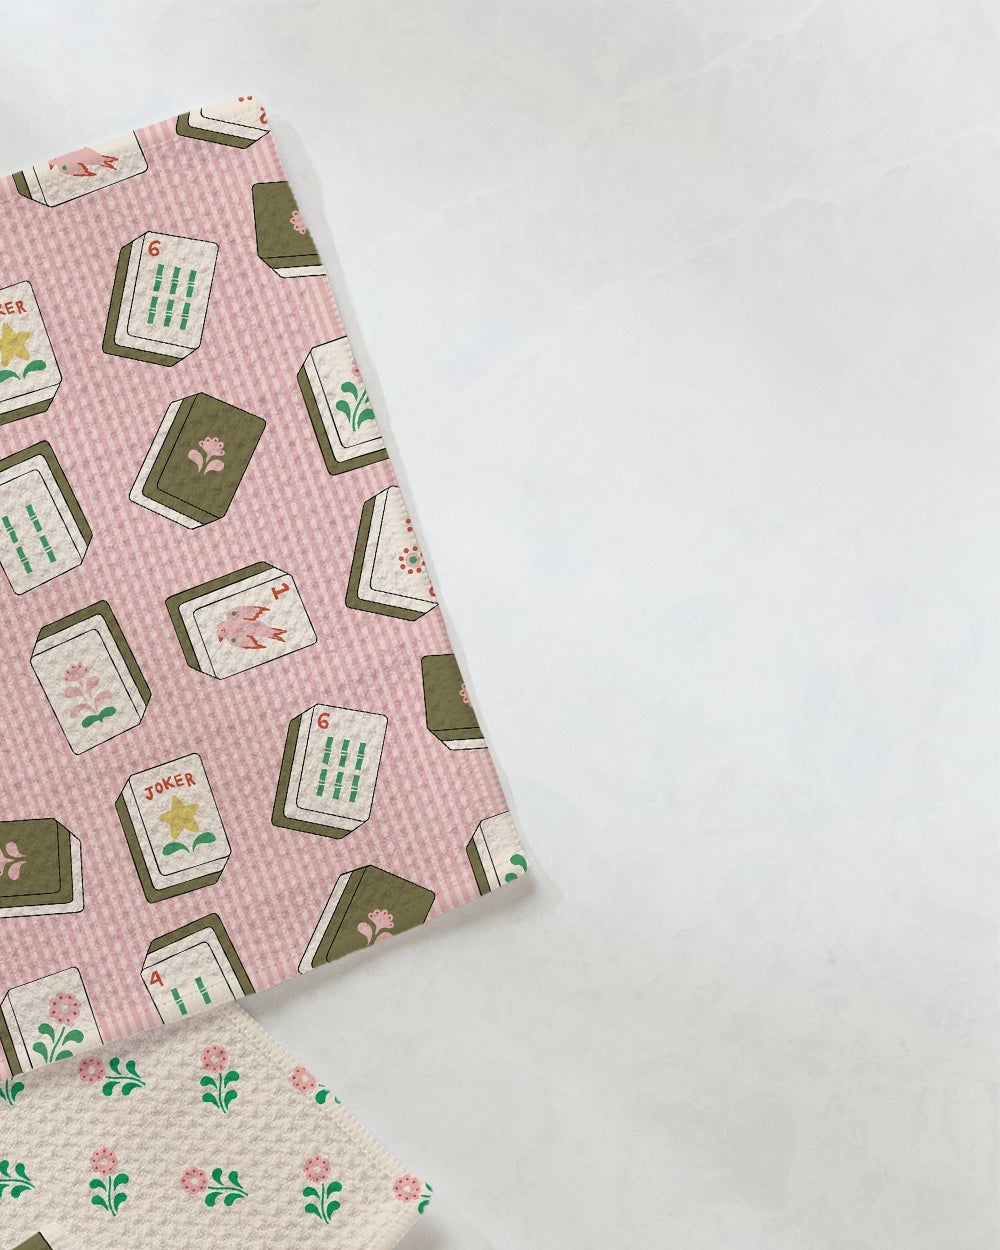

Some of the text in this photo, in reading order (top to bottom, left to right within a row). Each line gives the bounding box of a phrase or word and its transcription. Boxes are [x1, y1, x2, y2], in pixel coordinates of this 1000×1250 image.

[147, 239, 161, 257] 6
[270, 582, 290, 601] 1
[317, 711, 331, 730] 6
[145, 772, 196, 801] JOKER
[149, 970, 165, 987] 4
